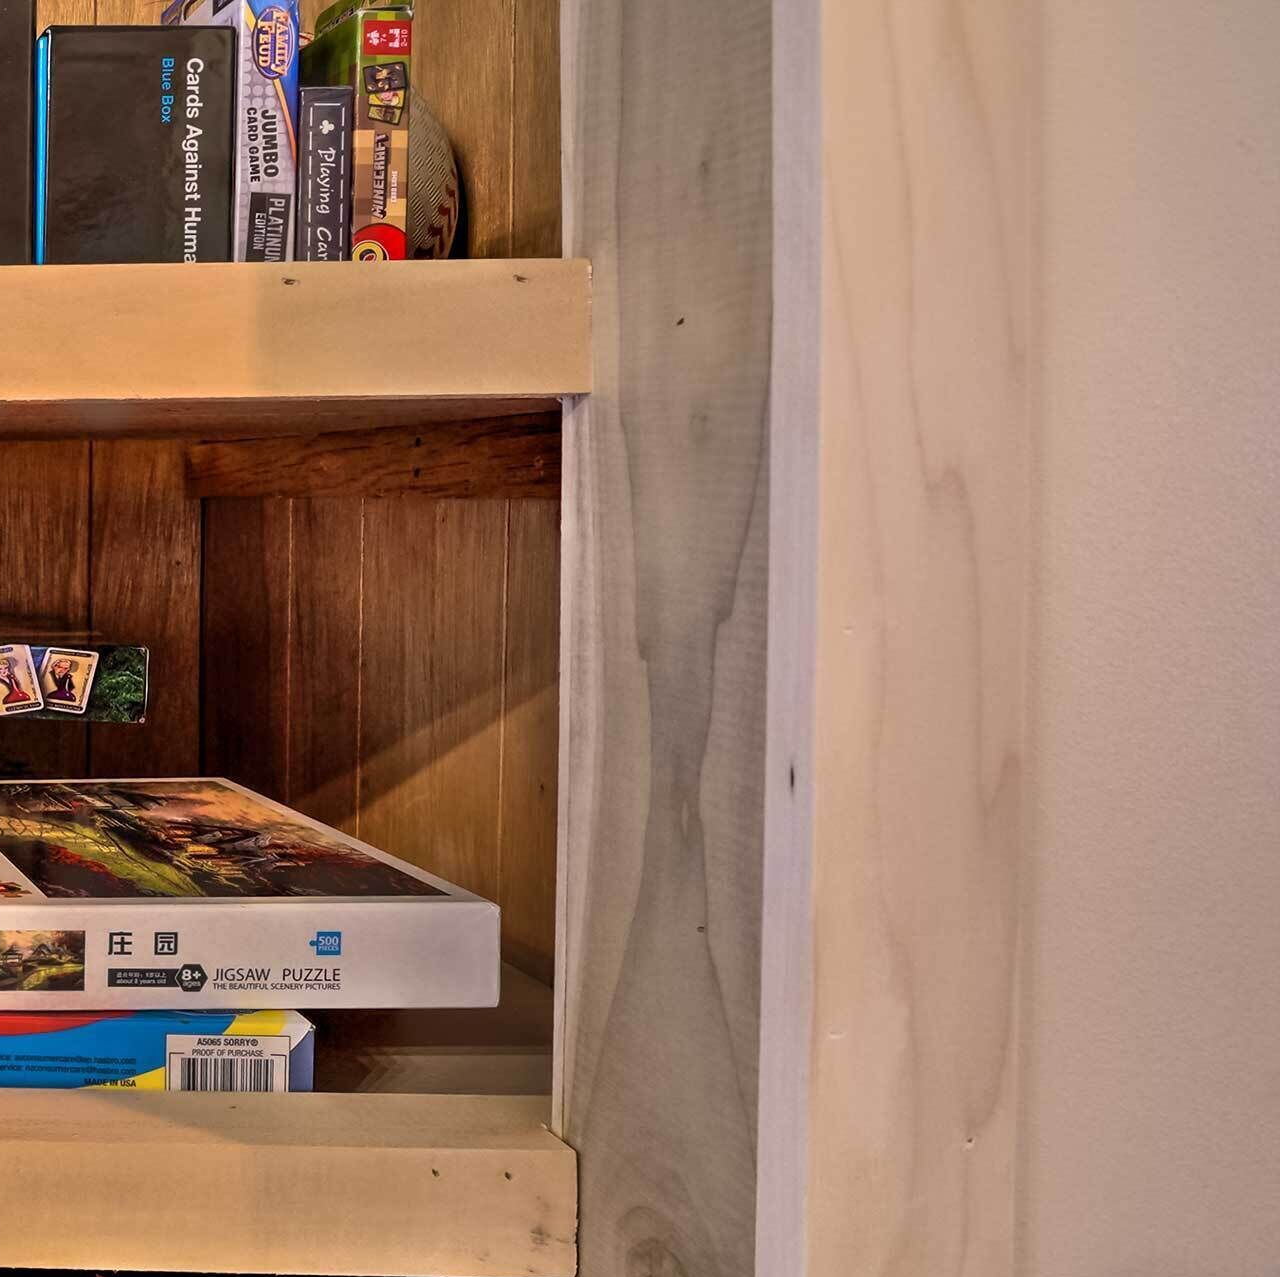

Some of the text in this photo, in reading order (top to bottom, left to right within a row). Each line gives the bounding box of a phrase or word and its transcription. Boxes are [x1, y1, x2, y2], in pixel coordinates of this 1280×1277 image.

[258, 20, 273, 68] FEUD
[272, 11, 290, 77] FAMILY
[161, 57, 175, 124] Blue Box
[185, 57, 204, 119] Cards
[181, 124, 204, 202] Against
[246, 107, 261, 183] CARD GAME
[261, 109, 279, 179] JUMBO
[315, 146, 336, 215] Playing
[371, 133, 389, 219] MINECRAFT
[252, 212, 266, 250] EDITION
[107, 931, 133, 956] 庄
[318, 936, 340, 946] 500
[181, 969, 202, 981] 8+
[212, 968, 341, 982] JIGSAW PUZZLE
[213, 982, 227, 990] THE
[270, 983, 304, 991] SCENERY
[305, 983, 341, 991] PICTURES
[191, 1049, 264, 1057] PROOF OF PURCHASE
[196, 1037, 222, 1047] A5065
[84, 1078, 137, 1088] MADE IN USA
